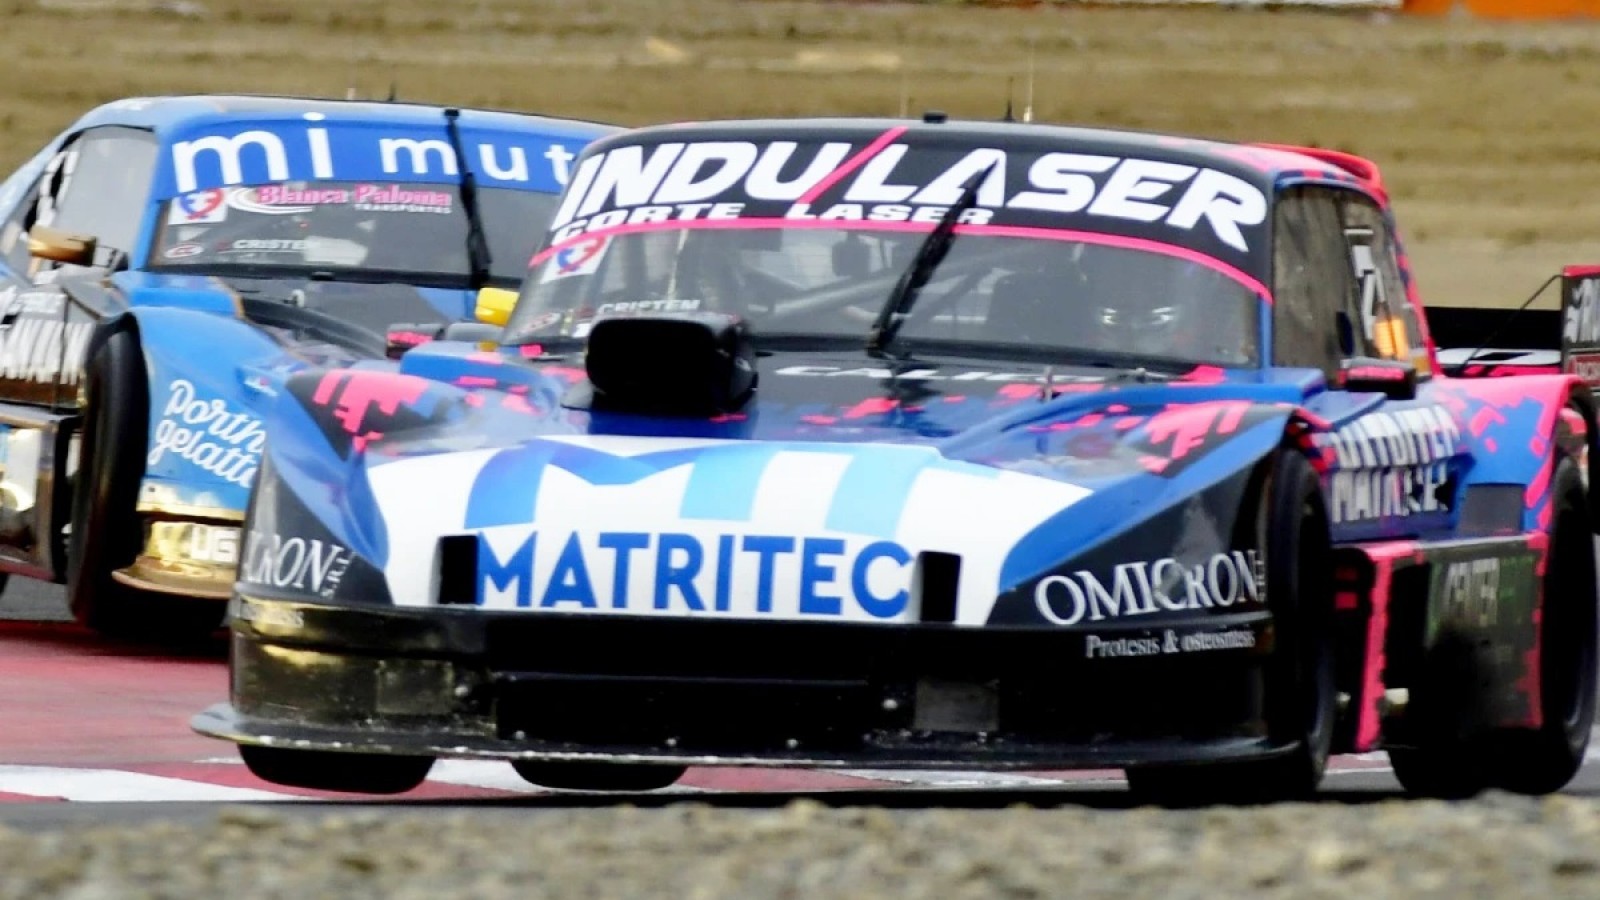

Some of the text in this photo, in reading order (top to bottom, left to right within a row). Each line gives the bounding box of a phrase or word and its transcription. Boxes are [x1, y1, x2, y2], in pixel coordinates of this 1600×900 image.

[172, 111, 334, 193] mi
[258, 183, 453, 208] Blanca Paloma
[553, 203, 995, 240] CORTE LASER
[478, 530, 911, 619] MATRITEC
[1035, 550, 1258, 625] OMICRON
[1163, 628, 1180, 653] &
